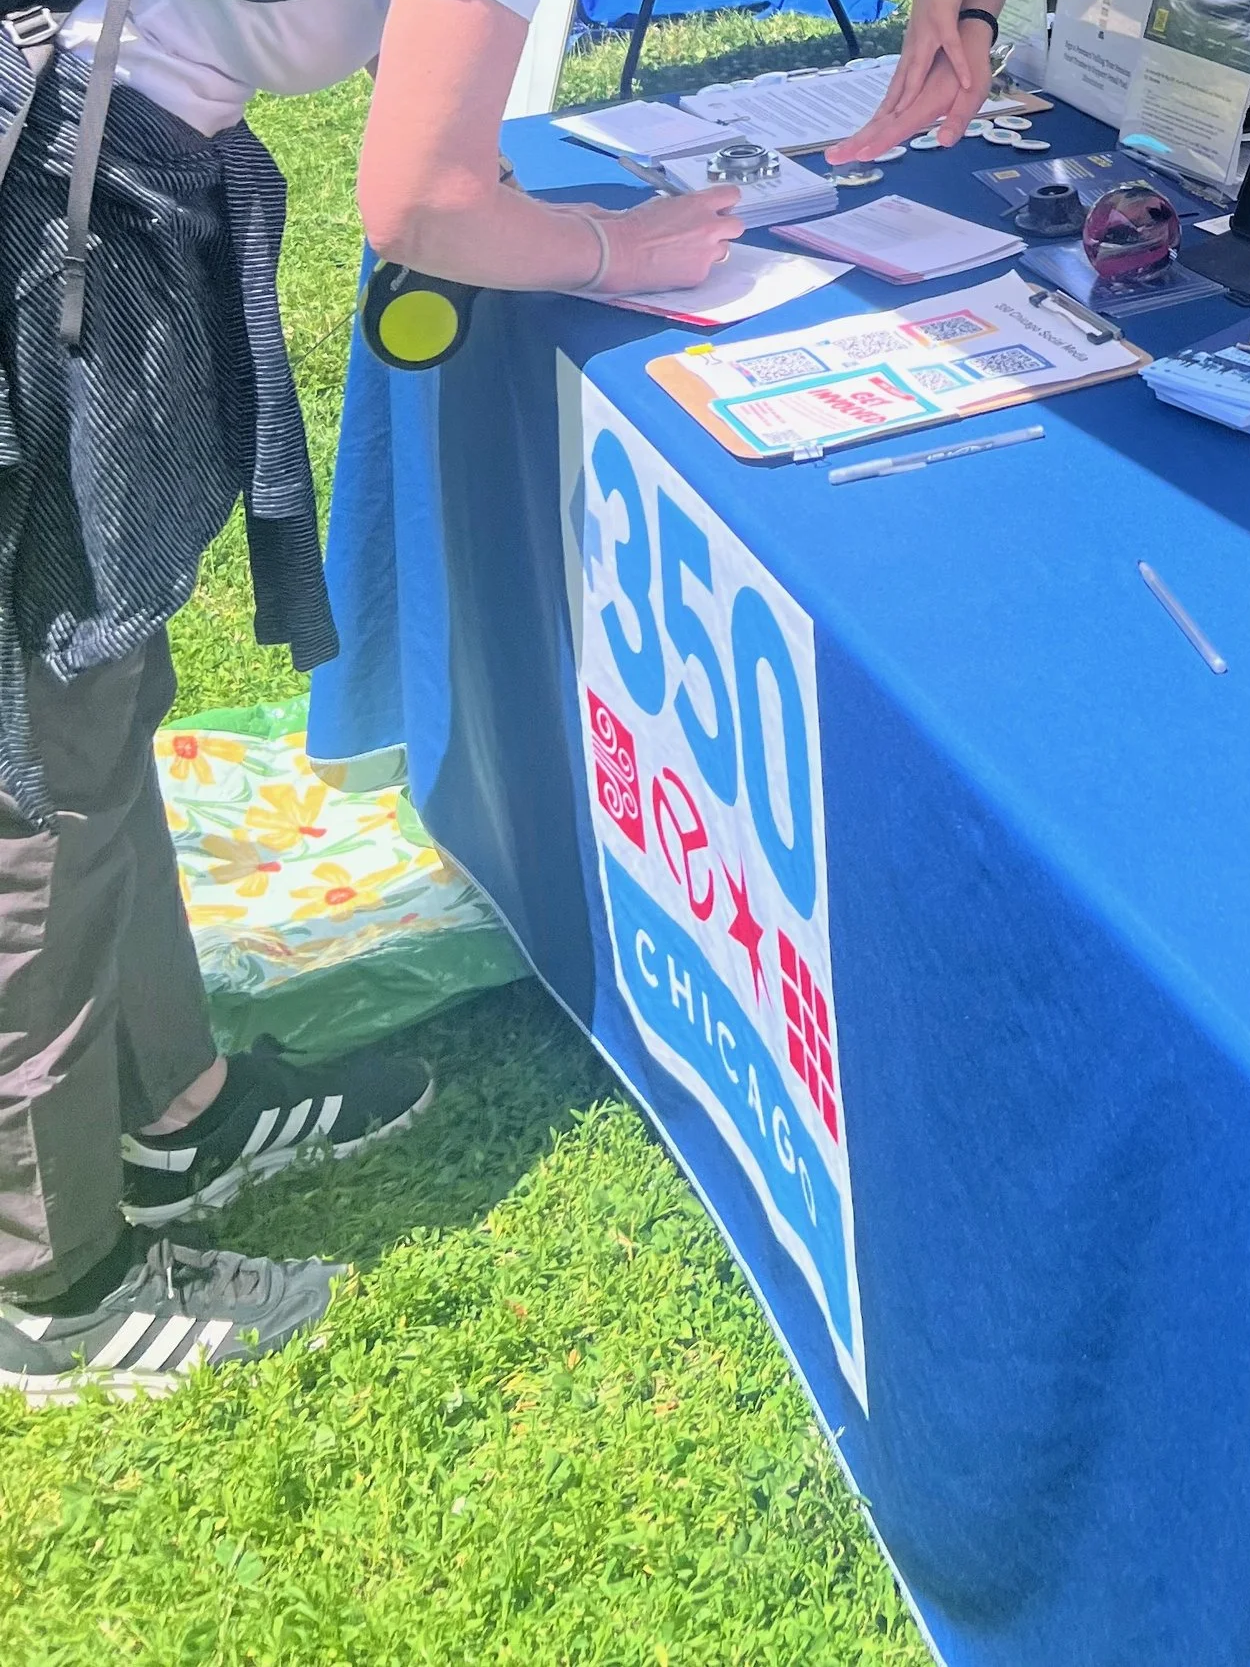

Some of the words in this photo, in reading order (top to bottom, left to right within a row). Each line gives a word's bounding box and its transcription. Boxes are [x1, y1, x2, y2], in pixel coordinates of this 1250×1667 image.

[807, 388, 887, 424] INVOLVED
[849, 391, 895, 407] GET
[592, 428, 817, 920] 350
[635, 927, 819, 1226] CHICAGO
